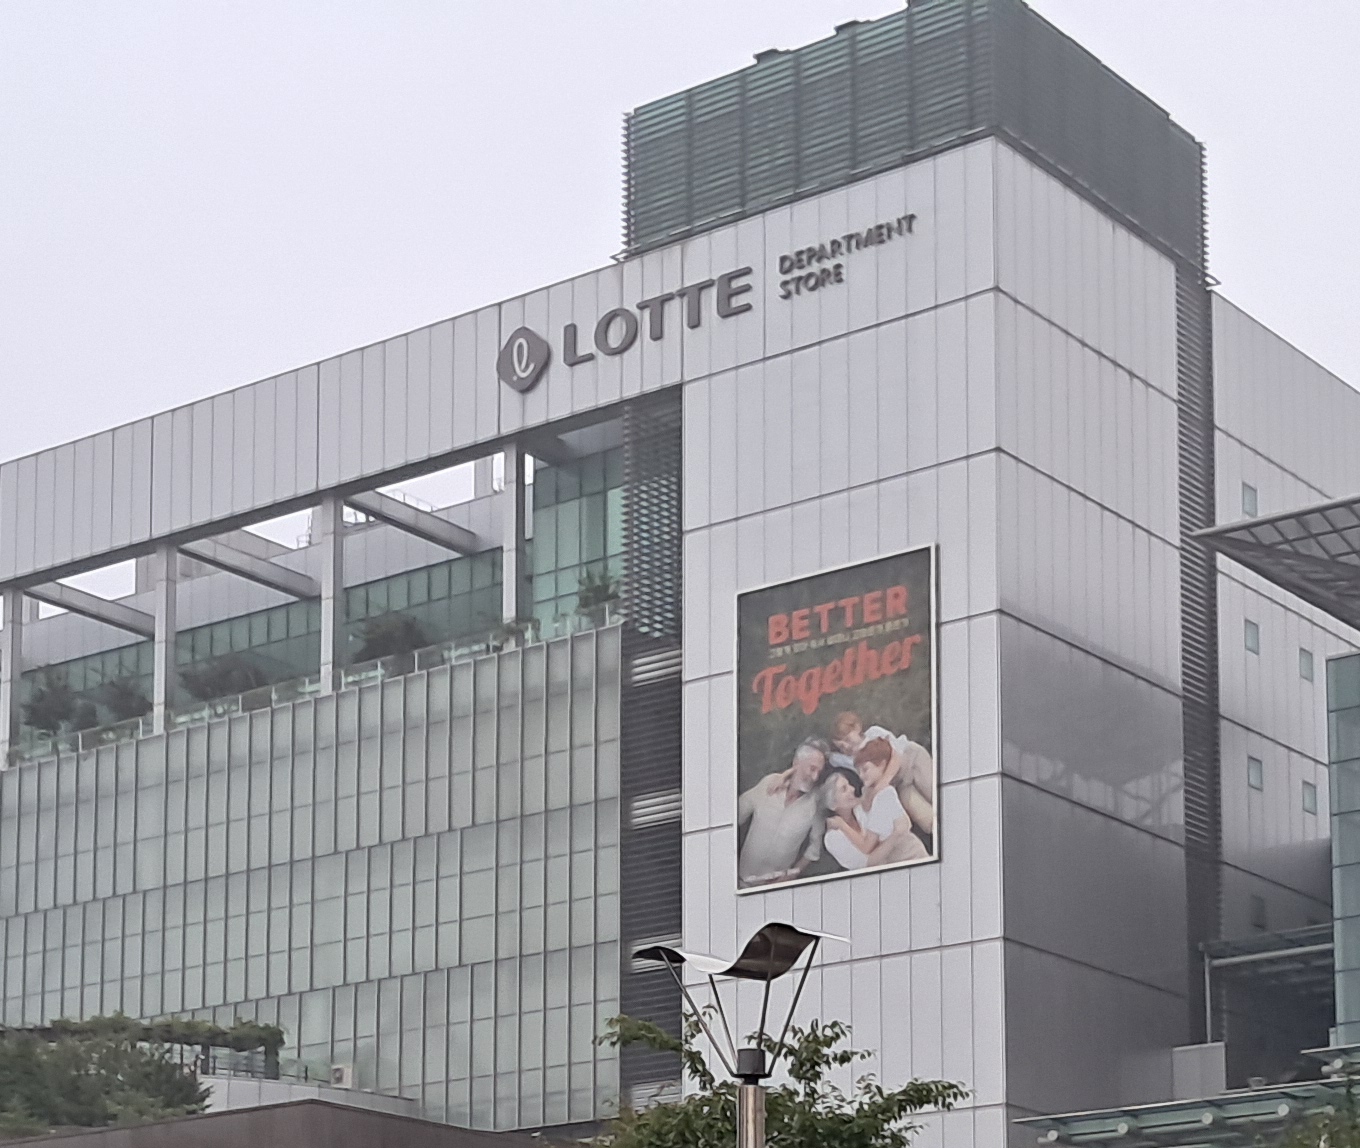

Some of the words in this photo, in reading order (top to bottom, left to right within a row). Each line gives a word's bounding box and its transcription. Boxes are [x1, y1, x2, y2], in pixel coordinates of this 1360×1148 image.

[778, 213, 918, 276] DEPARTMENT
[778, 264, 846, 300] STORE
[562, 266, 753, 367] LOTTE
[767, 584, 909, 645] BETTER
[751, 634, 923, 716] Together
